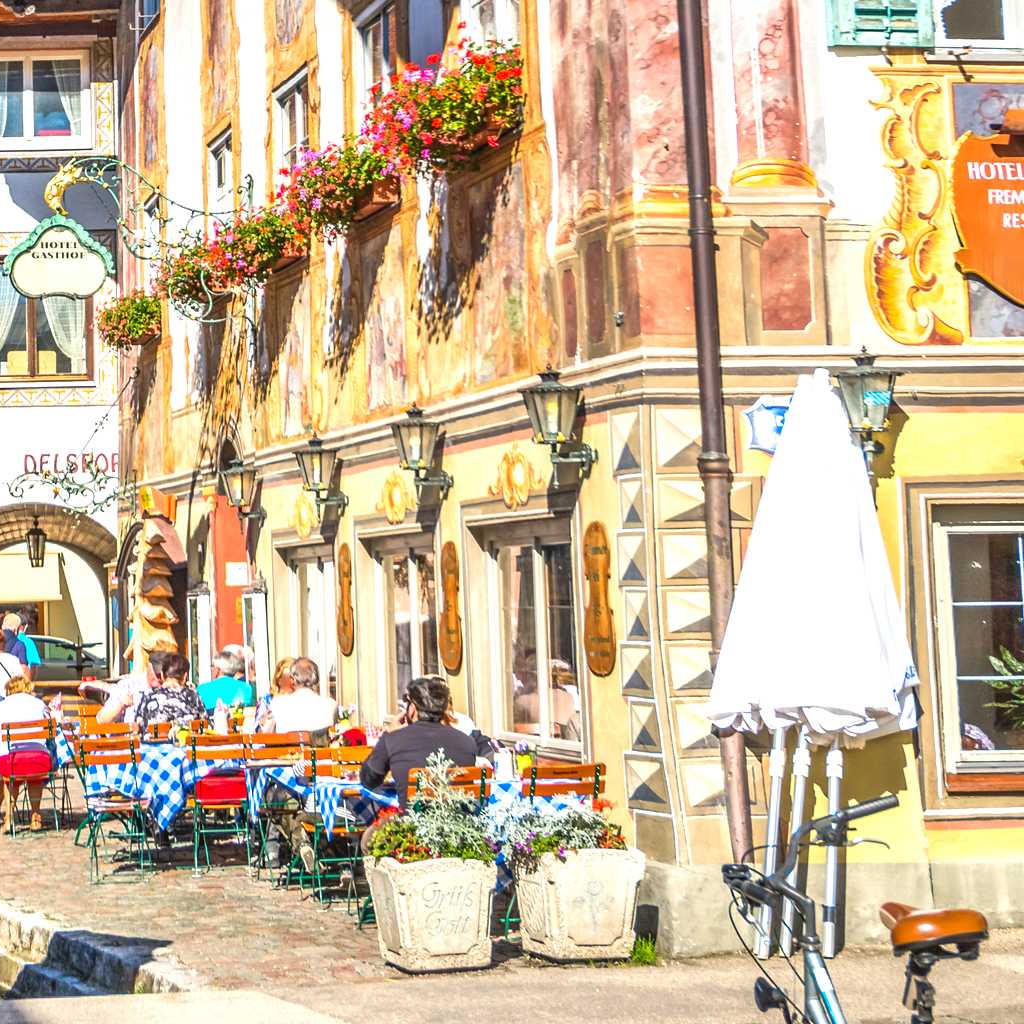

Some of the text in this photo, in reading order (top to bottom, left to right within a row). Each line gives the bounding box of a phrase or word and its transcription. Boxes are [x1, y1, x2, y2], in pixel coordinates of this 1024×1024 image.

[967, 161, 1024, 181] HOTEL
[987, 189, 1024, 205] FREM
[40, 241, 78, 249] HOTEL
[31, 251, 86, 260] GASTHOF
